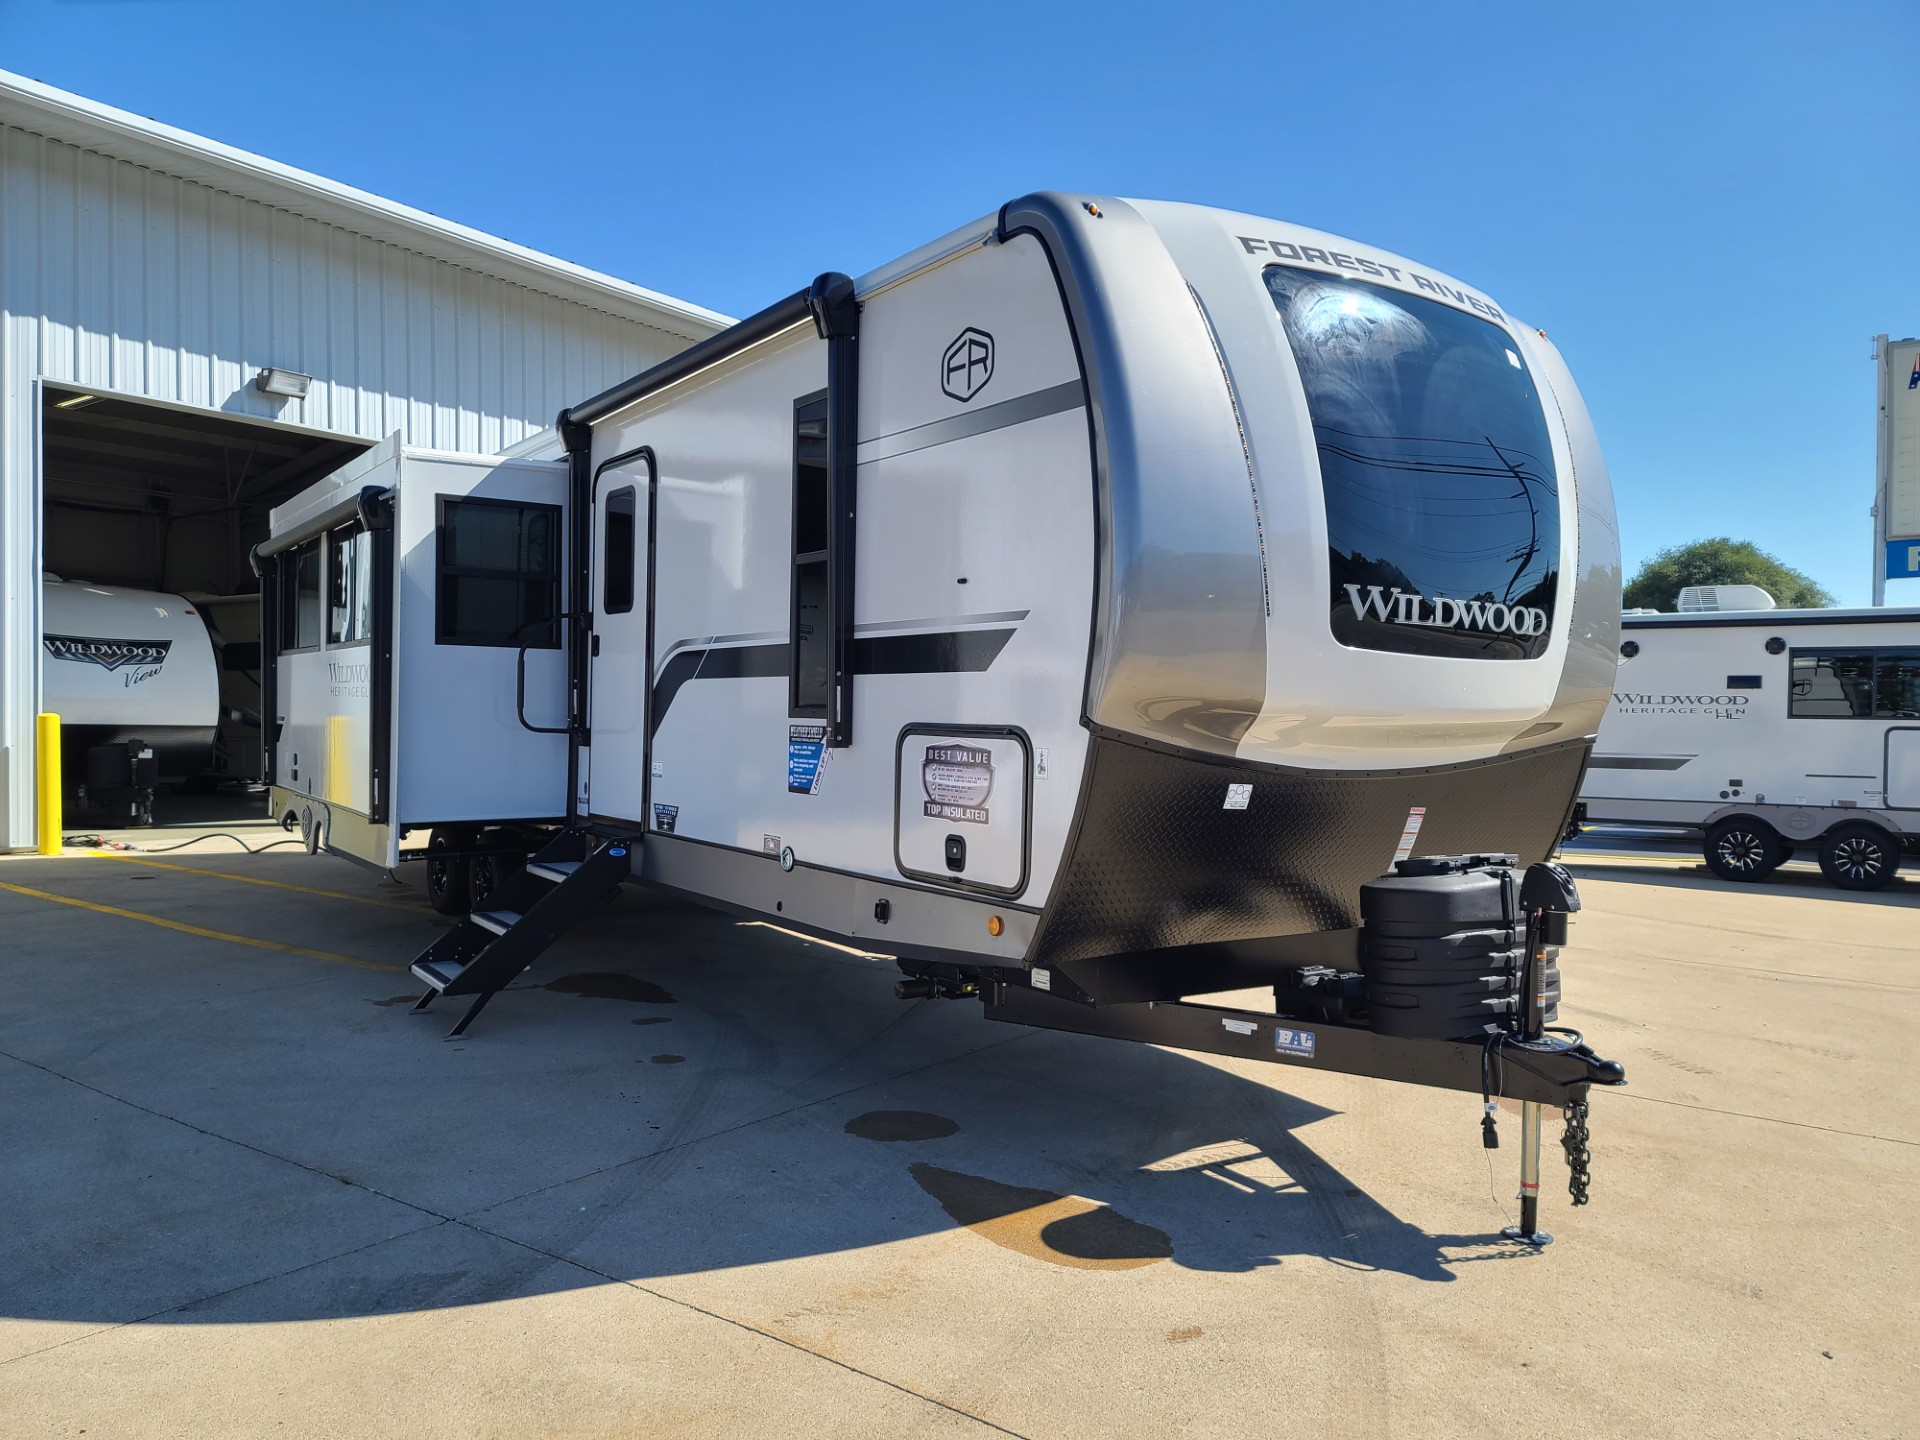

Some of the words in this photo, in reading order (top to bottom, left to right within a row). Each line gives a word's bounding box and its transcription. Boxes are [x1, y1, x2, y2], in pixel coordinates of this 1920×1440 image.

[1236, 236, 1402, 282] FOREST
[1410, 272, 1507, 325] RIVER
[1343, 583, 1547, 636] WILDWOOD
[44, 640, 166, 657] WILDWOOD
[124, 665, 163, 688] View
[328, 662, 370, 683] WILDWO
[330, 686, 360, 698] HERITAGE
[361, 686, 369, 698] GL
[1612, 693, 1750, 706] WILDWOOD
[1704, 707, 1746, 715] GLEN
[1715, 712, 1741, 720] HL
[928, 749, 952, 761] BEST
[957, 751, 989, 764] VALUE
[926, 803, 941, 815] TOP
[942, 805, 986, 821] INSULATED
